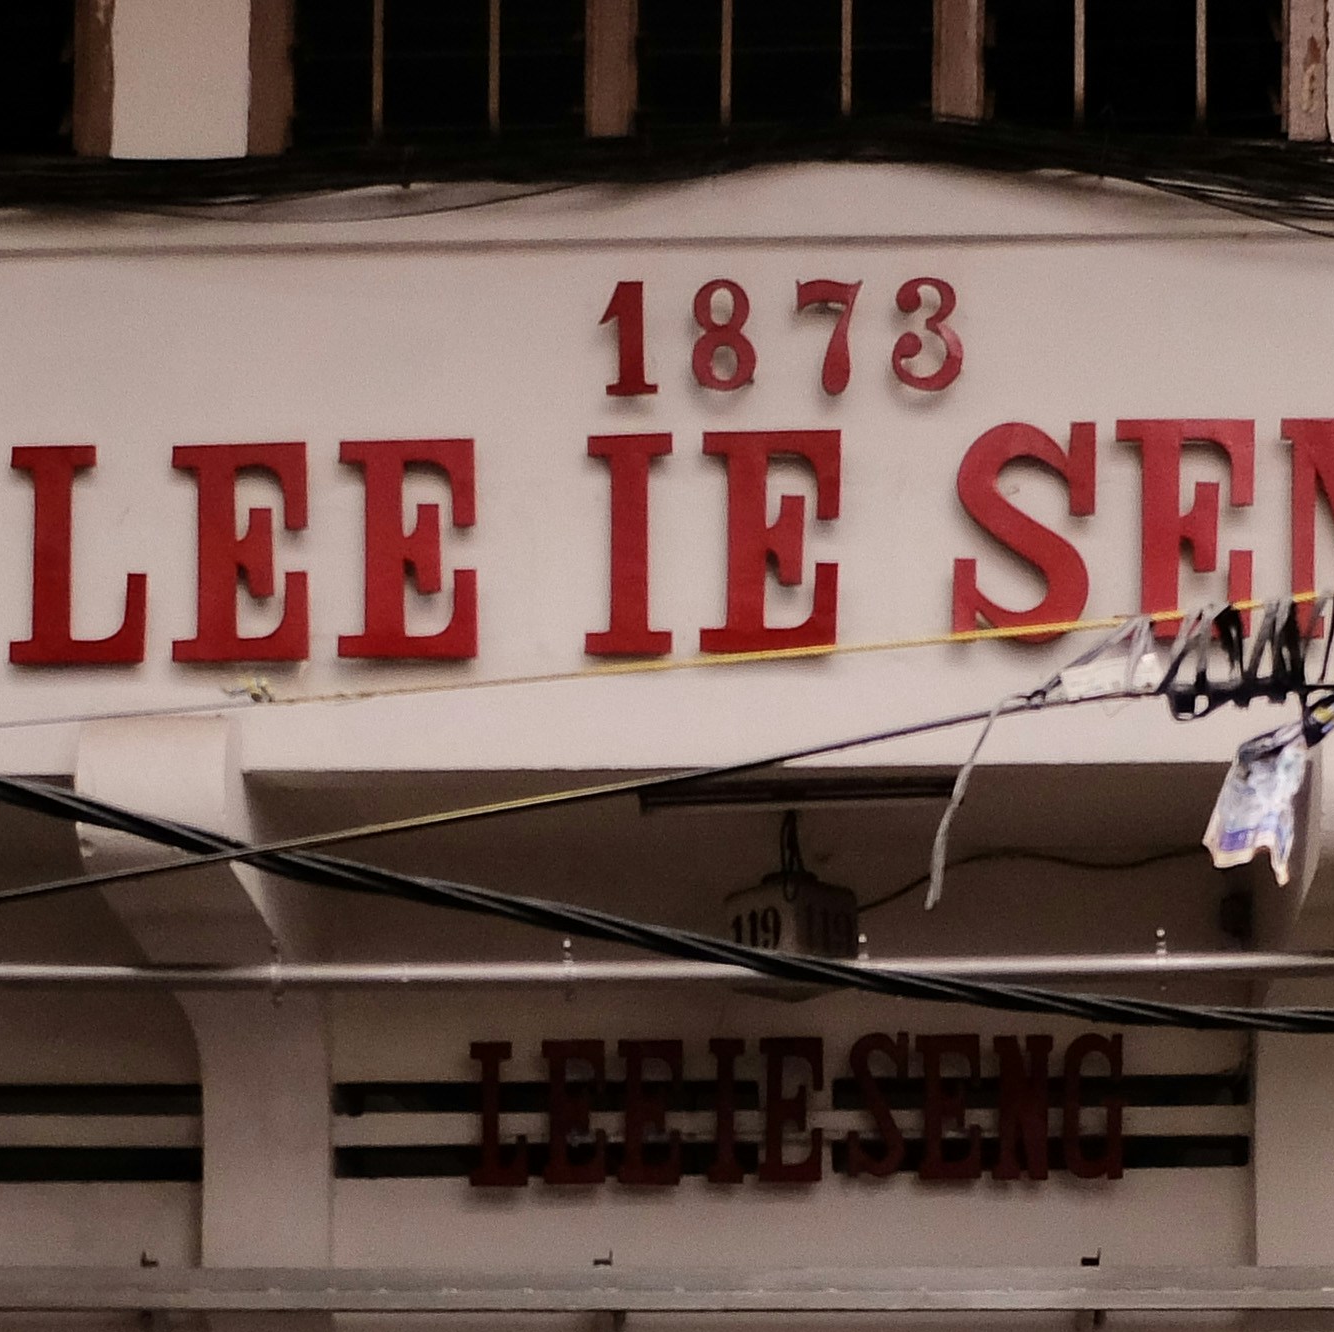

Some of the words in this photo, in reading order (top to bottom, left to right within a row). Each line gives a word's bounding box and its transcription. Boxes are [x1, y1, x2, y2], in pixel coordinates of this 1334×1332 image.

[598, 276, 964, 396] 1873
[8, 438, 478, 665] LEE
[583, 428, 842, 657] IE
[732, 906, 782, 949] 119
[469, 1038, 683, 1187] LEE
[707, 1037, 824, 1182] IE
[846, 1032, 1124, 1180] SENG
